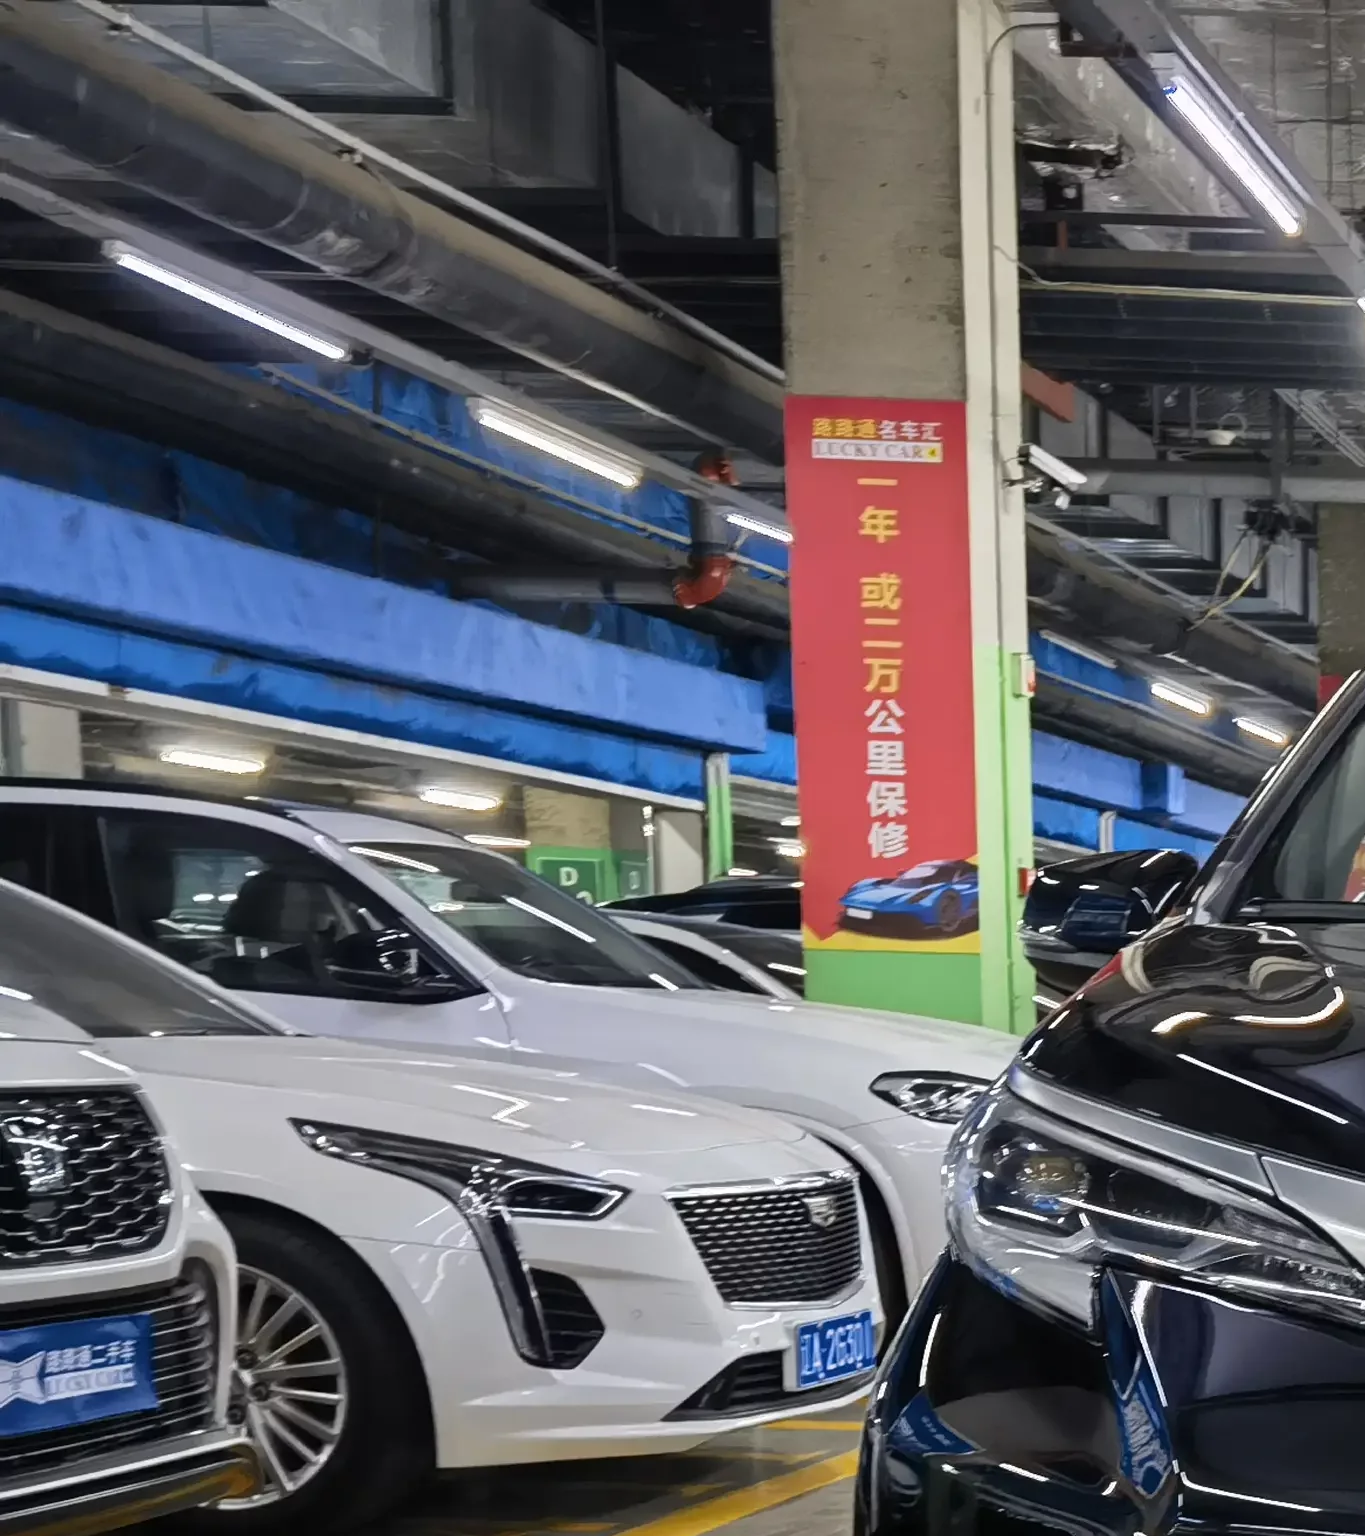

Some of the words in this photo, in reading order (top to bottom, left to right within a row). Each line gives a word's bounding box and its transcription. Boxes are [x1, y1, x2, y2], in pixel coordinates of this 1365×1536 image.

[815, 442, 879, 457] LUCKY
[885, 444, 922, 458] CAR
[559, 866, 579, 887] D
